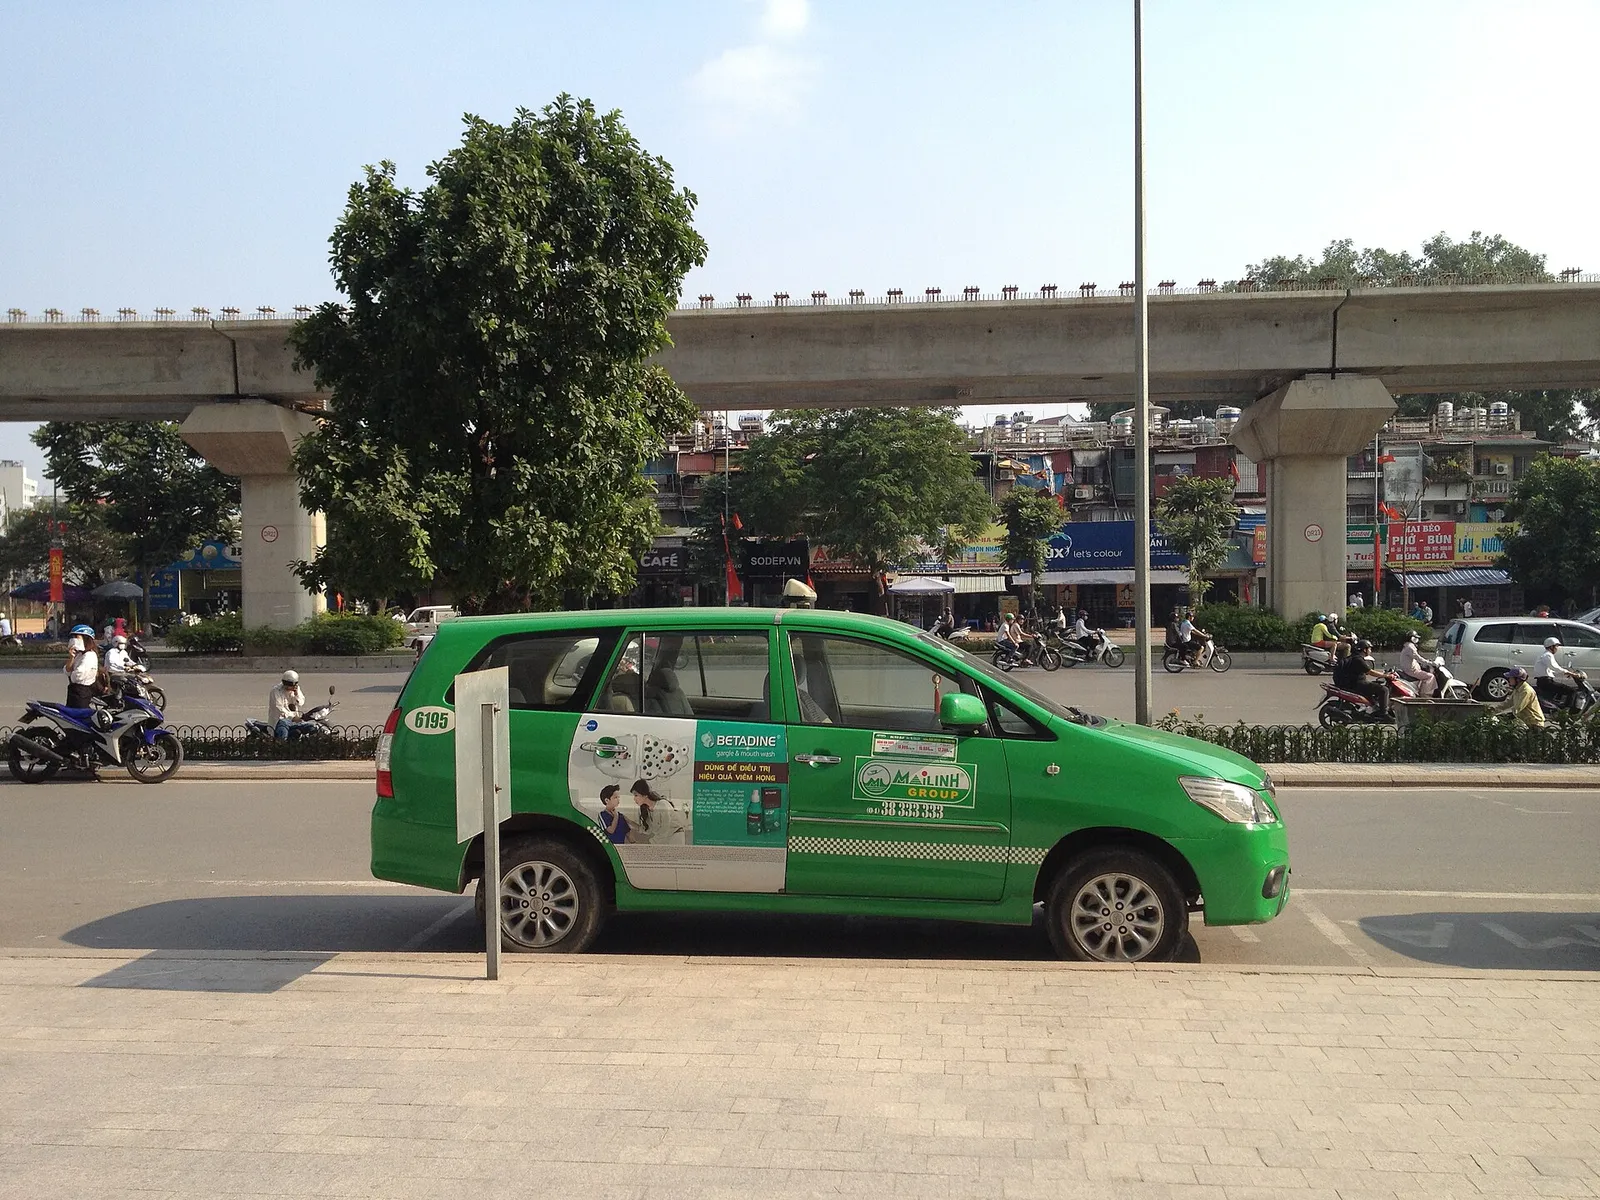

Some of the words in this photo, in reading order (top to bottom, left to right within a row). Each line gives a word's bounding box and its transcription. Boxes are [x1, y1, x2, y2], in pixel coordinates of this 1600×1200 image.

[1427, 533, 1452, 545] BÚN
[1073, 550, 1091, 558] let's
[1093, 549, 1122, 558] colour
[641, 553, 678, 567] CAFÉ
[750, 557, 801, 566] SODEP.VN
[415, 711, 449, 729] 6195
[716, 735, 776, 747] BETADINE
[716, 750, 734, 758] gargle
[759, 765, 771, 773] TRỊ
[756, 774, 776, 782] HỌNG
[907, 787, 959, 799] GROUP
[881, 801, 896, 816] 38
[898, 802, 920, 818] 333
[922, 803, 944, 819] 333
